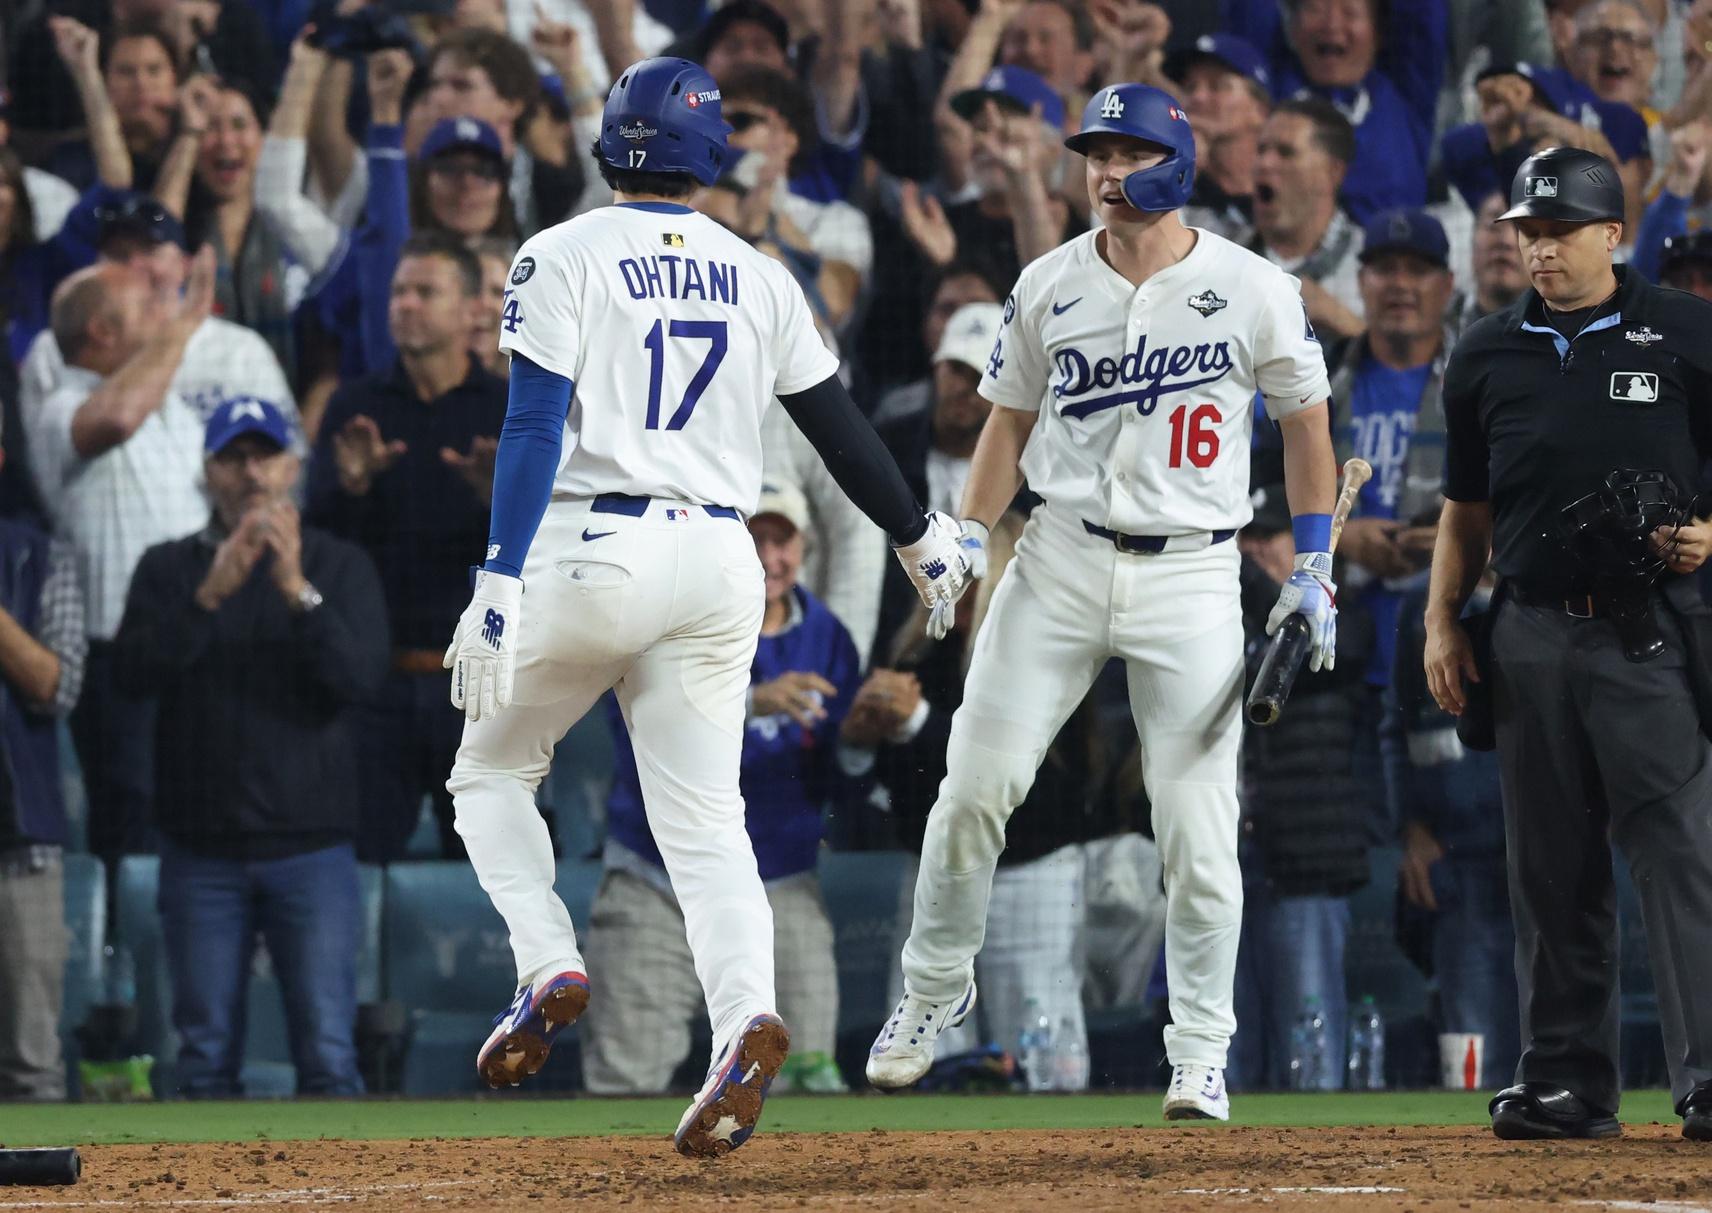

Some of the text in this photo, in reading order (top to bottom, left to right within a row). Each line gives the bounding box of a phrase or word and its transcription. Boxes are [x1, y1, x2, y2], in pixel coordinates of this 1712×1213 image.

[1101, 89, 1125, 119] LA
[628, 149, 647, 169] 17
[618, 255, 739, 306] OHTANI
[644, 318, 728, 431] 17
[1053, 334, 1234, 421] Dodgers
[1168, 404, 1223, 469] 16
